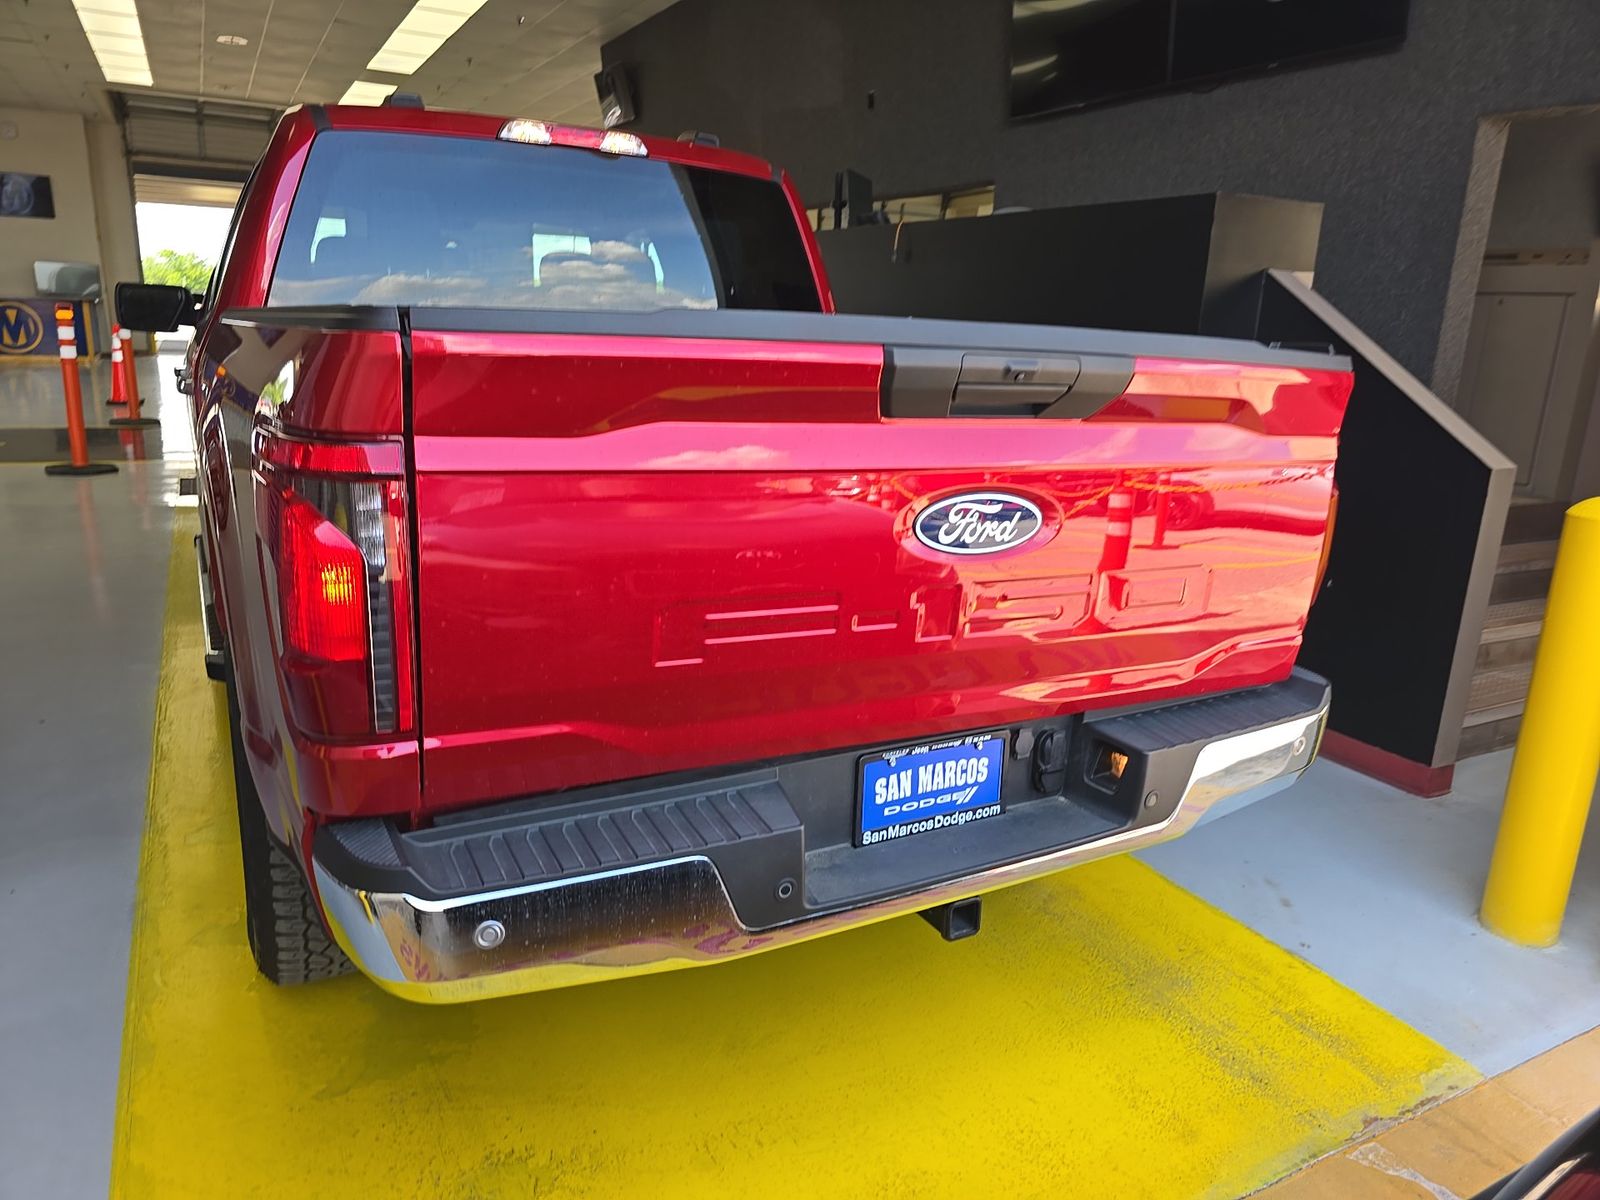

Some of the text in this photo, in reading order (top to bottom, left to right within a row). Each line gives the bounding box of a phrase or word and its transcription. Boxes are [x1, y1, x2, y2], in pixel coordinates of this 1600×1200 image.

[938, 502, 1022, 545] Ford
[653, 563, 1213, 668] F-150
[874, 756, 989, 805] SAN MARCOS
[862, 804, 1001, 845] SanMarcosDodge.com
[883, 789, 968, 817] DODGE
